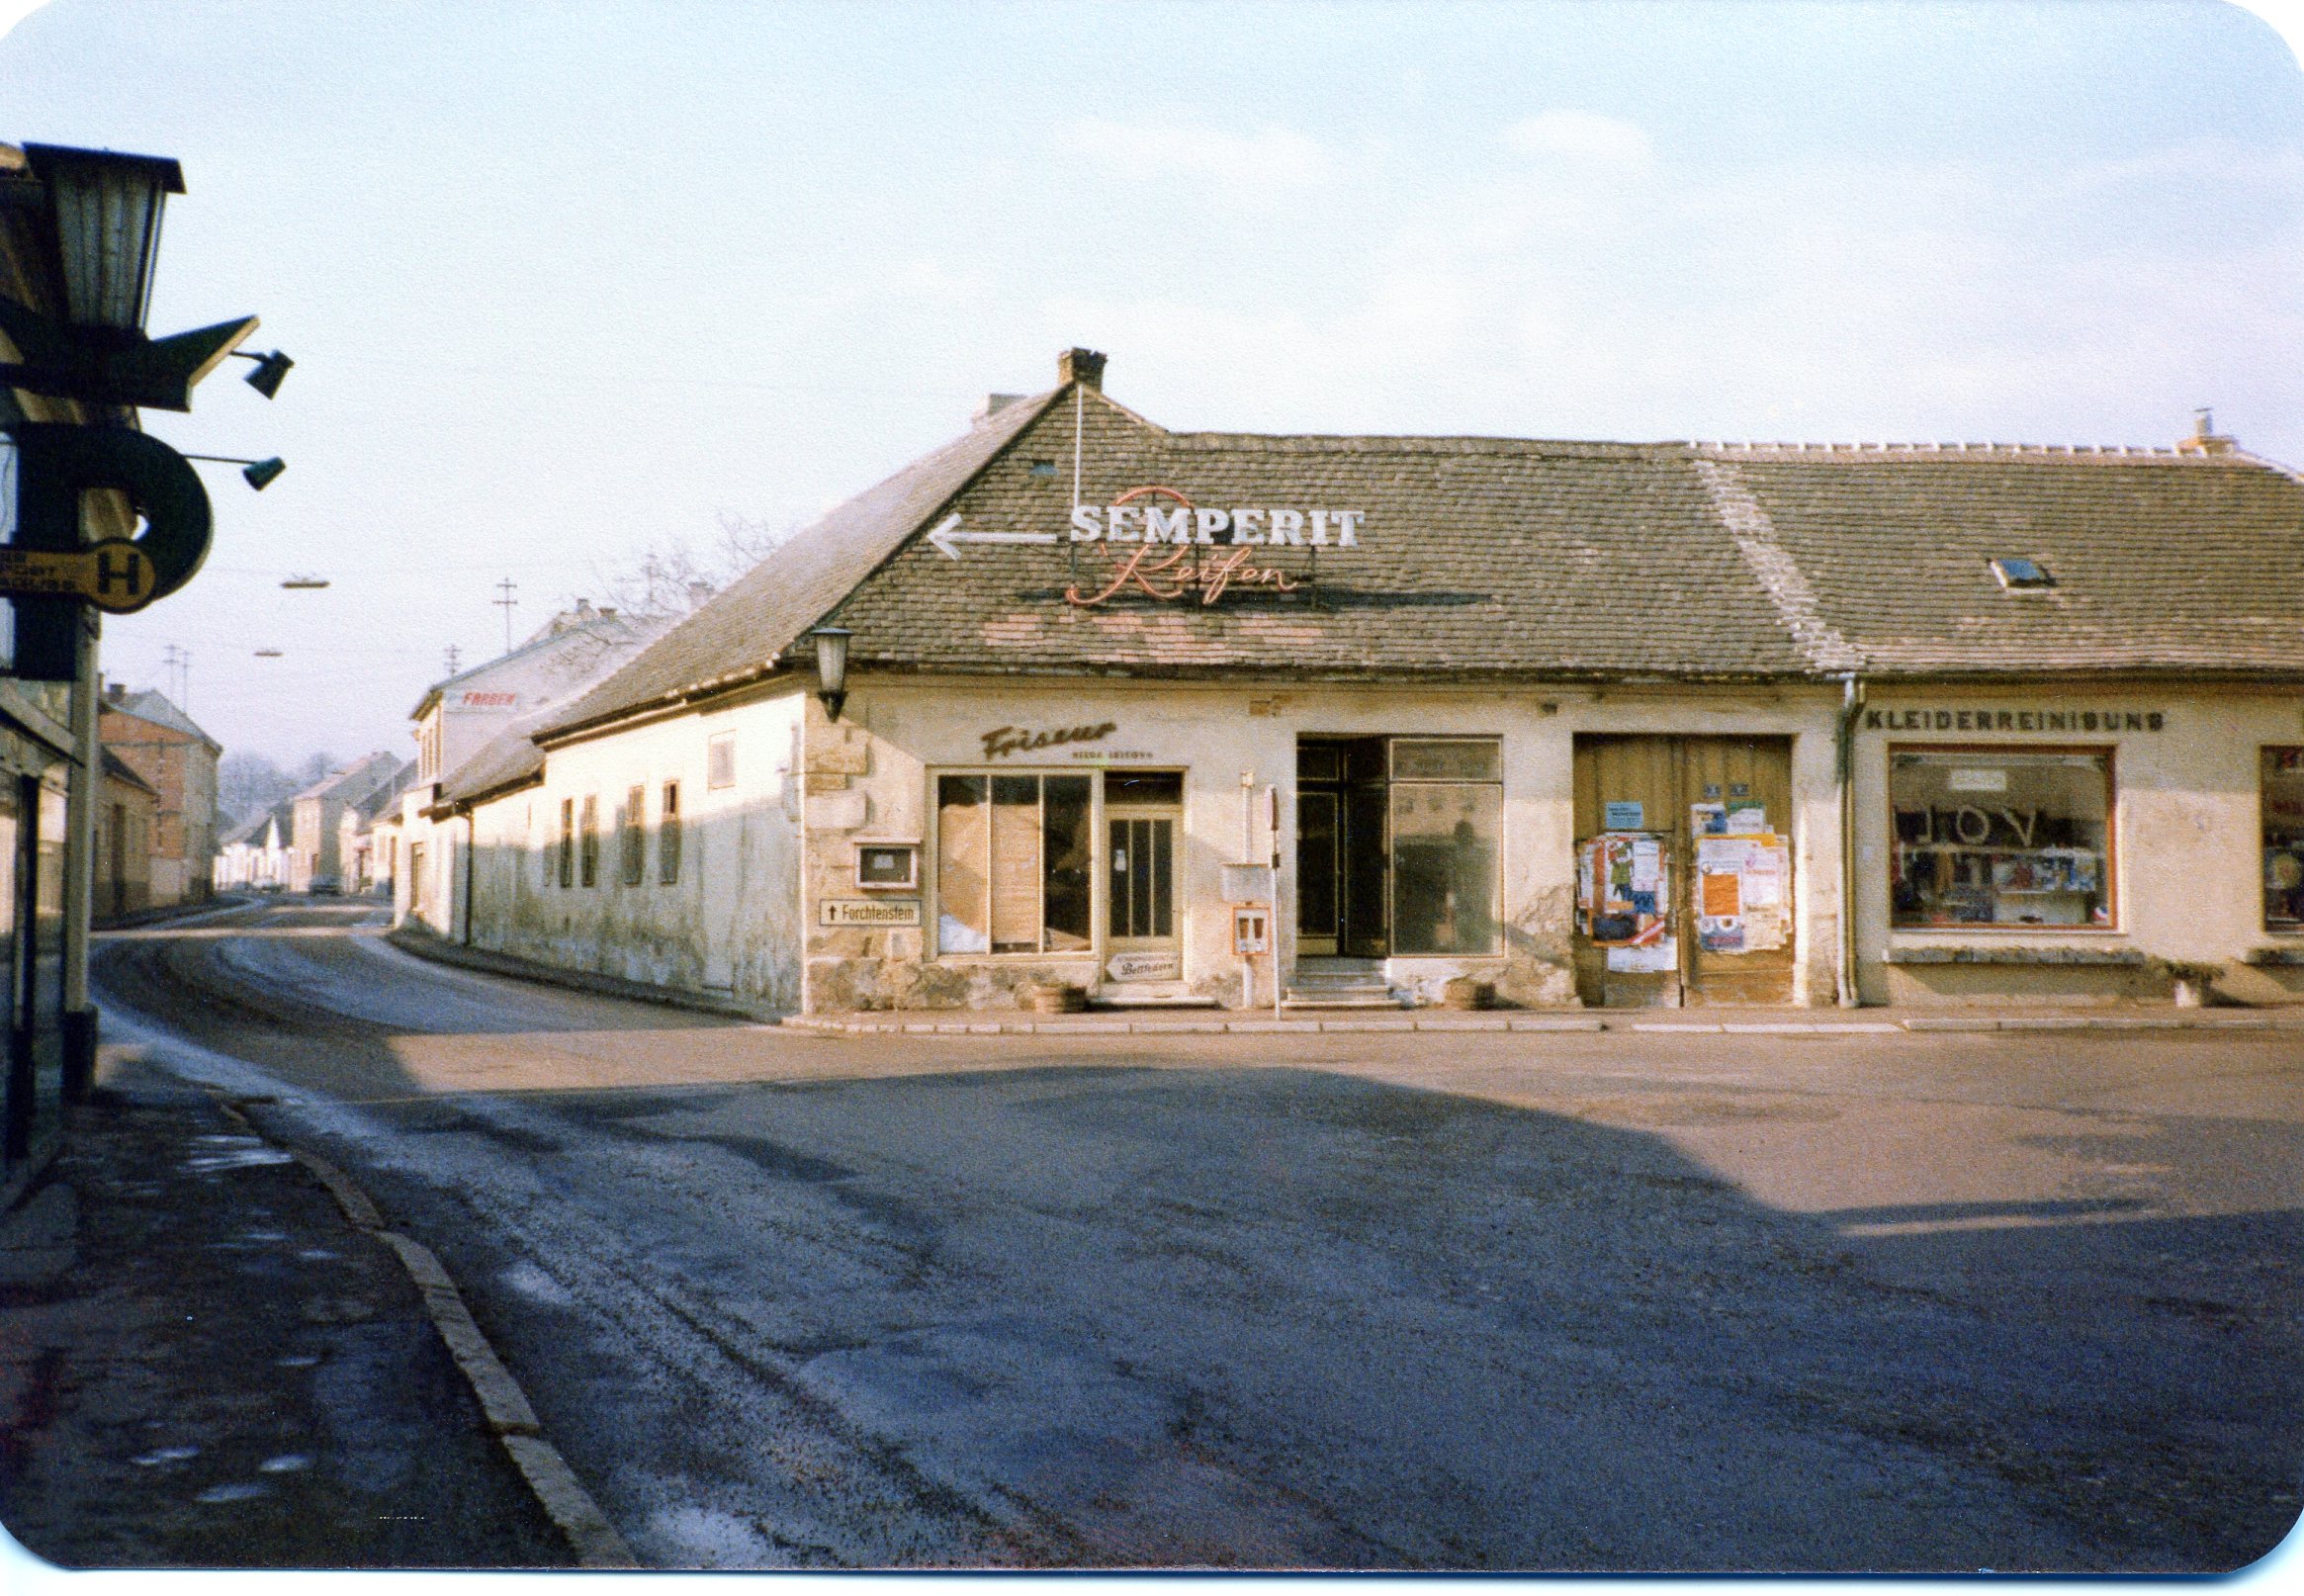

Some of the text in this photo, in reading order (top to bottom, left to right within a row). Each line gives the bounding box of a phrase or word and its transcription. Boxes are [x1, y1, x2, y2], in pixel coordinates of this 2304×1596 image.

[1065, 486, 1298, 606] Reifen
[1070, 504, 1366, 547] SEMPERIT
[98, 552, 139, 595] H
[1866, 709, 2164, 731] KLEIDERREINIGUNG
[981, 721, 1116, 761] Friseur
[842, 904, 914, 921] Forchtenstein
